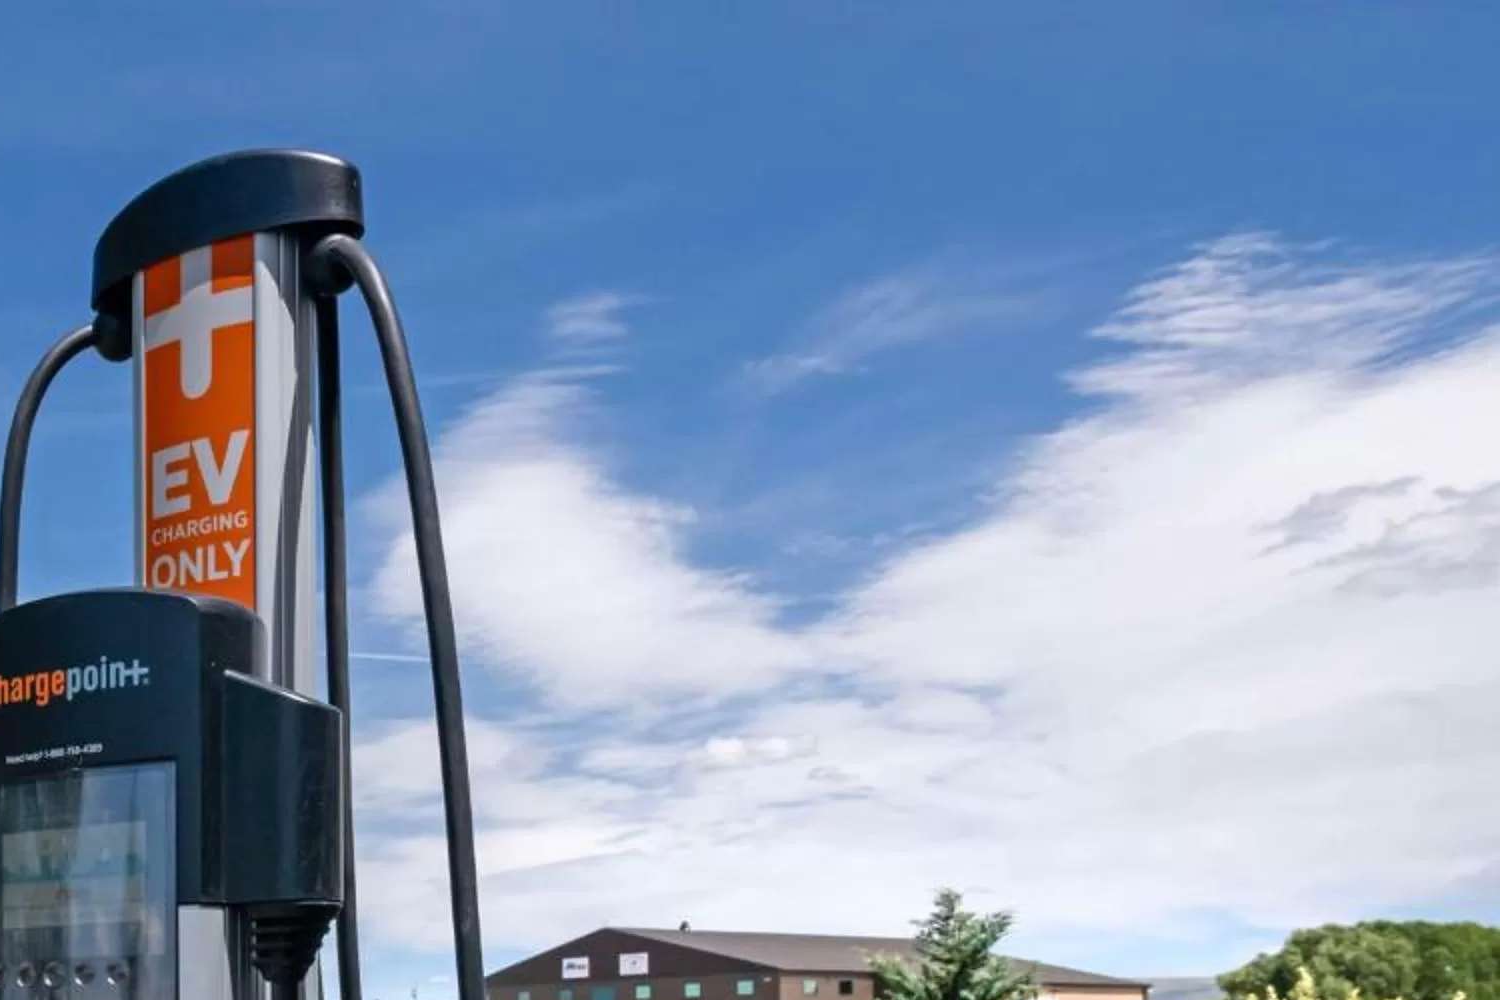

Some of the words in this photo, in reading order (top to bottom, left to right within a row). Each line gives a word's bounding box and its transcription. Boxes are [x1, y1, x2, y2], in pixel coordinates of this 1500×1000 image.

[152, 430, 250, 520] EV
[152, 510, 249, 546] CHARGING
[152, 538, 251, 589] ONLY
